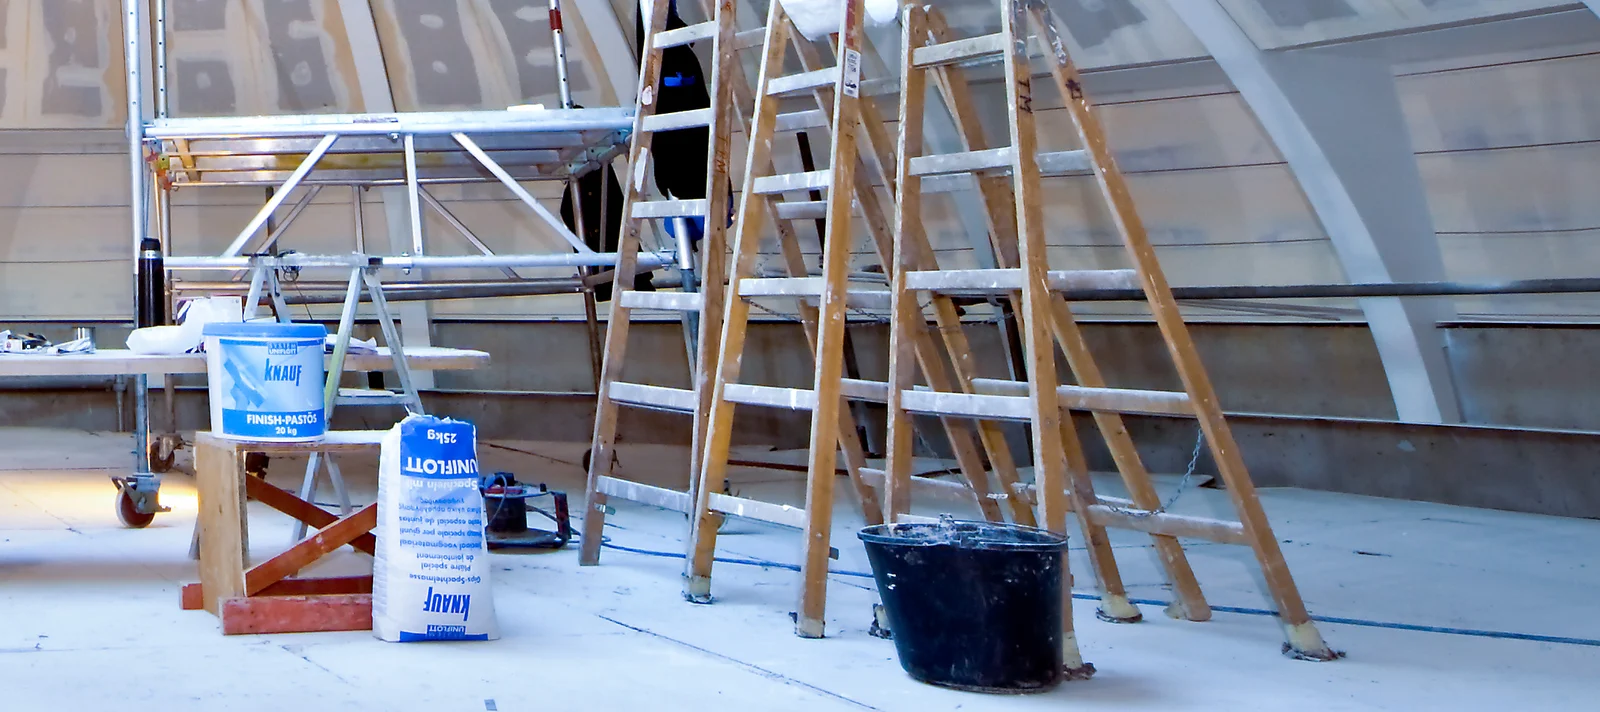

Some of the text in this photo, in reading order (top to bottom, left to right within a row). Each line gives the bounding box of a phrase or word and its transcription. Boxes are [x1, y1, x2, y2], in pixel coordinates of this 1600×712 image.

[264, 358, 302, 387] KNAUF
[246, 411, 317, 425] FINISH-PASTÖS
[275, 427, 297, 436] 20 kg
[427, 428, 457, 444] 25kg
[405, 456, 479, 475] UNIFLOTT
[416, 553, 474, 562] de jointoiement
[409, 573, 481, 585] Gips-Spachtelmasse
[423, 586, 471, 621] KNAUF
[428, 624, 465, 632] UNIFLOTT
